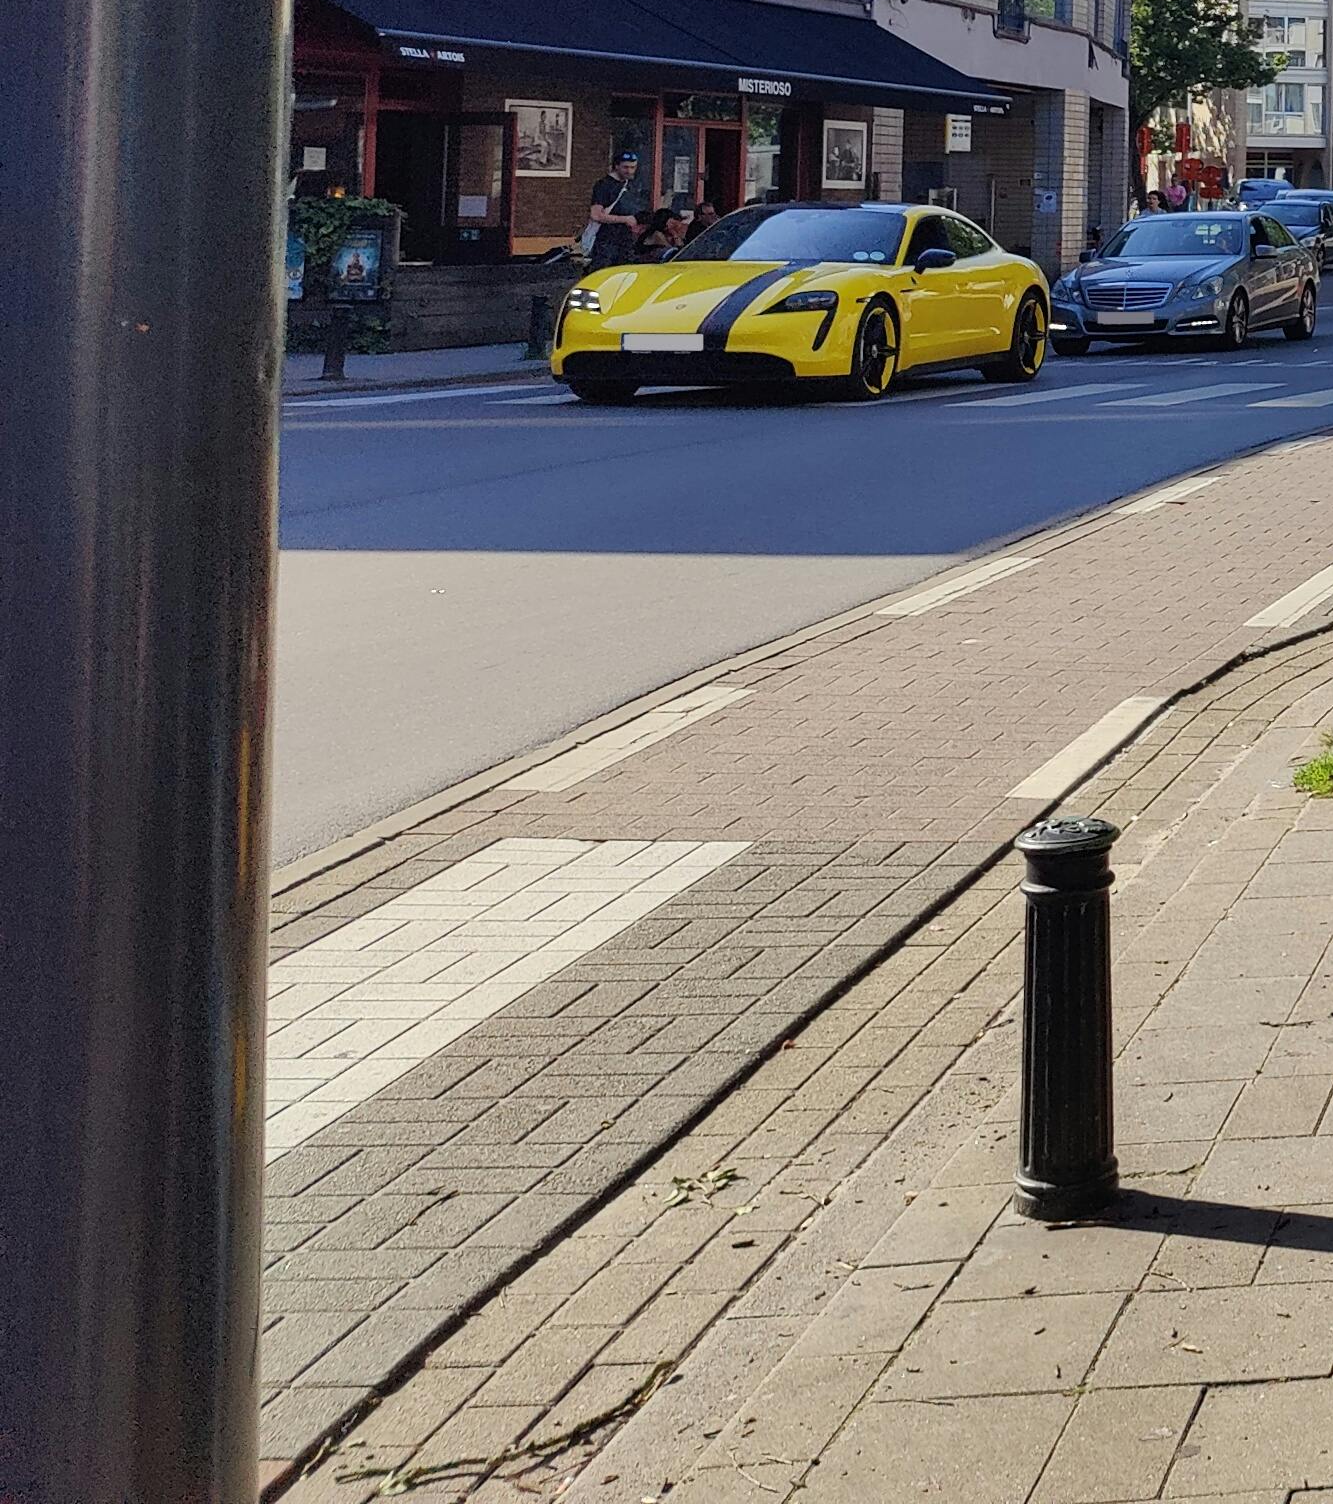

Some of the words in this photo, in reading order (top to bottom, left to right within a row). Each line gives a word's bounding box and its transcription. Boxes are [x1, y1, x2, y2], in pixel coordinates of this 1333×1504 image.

[400, 46, 430, 58] STELLA
[437, 50, 465, 63] ARTOIS
[738, 77, 792, 96] MISTERIOSO
